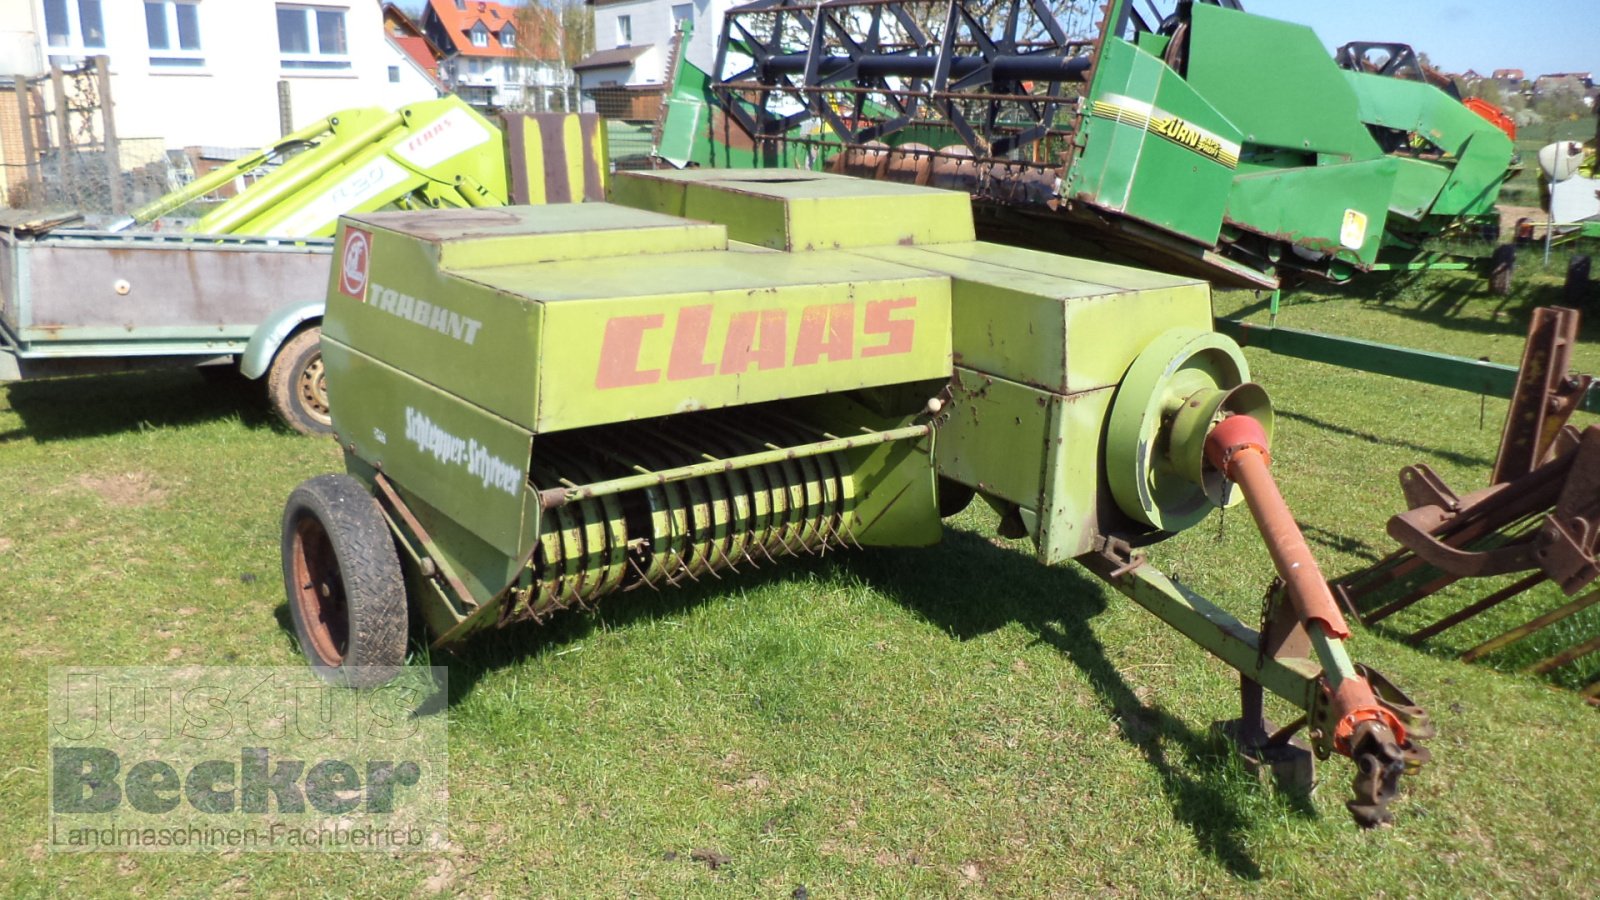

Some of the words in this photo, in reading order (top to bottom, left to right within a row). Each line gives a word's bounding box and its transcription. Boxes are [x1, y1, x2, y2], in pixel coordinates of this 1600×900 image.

[1157, 116, 1201, 148] ZÜRN
[370, 283, 482, 345] TRABANT
[595, 297, 917, 390] CLAAS
